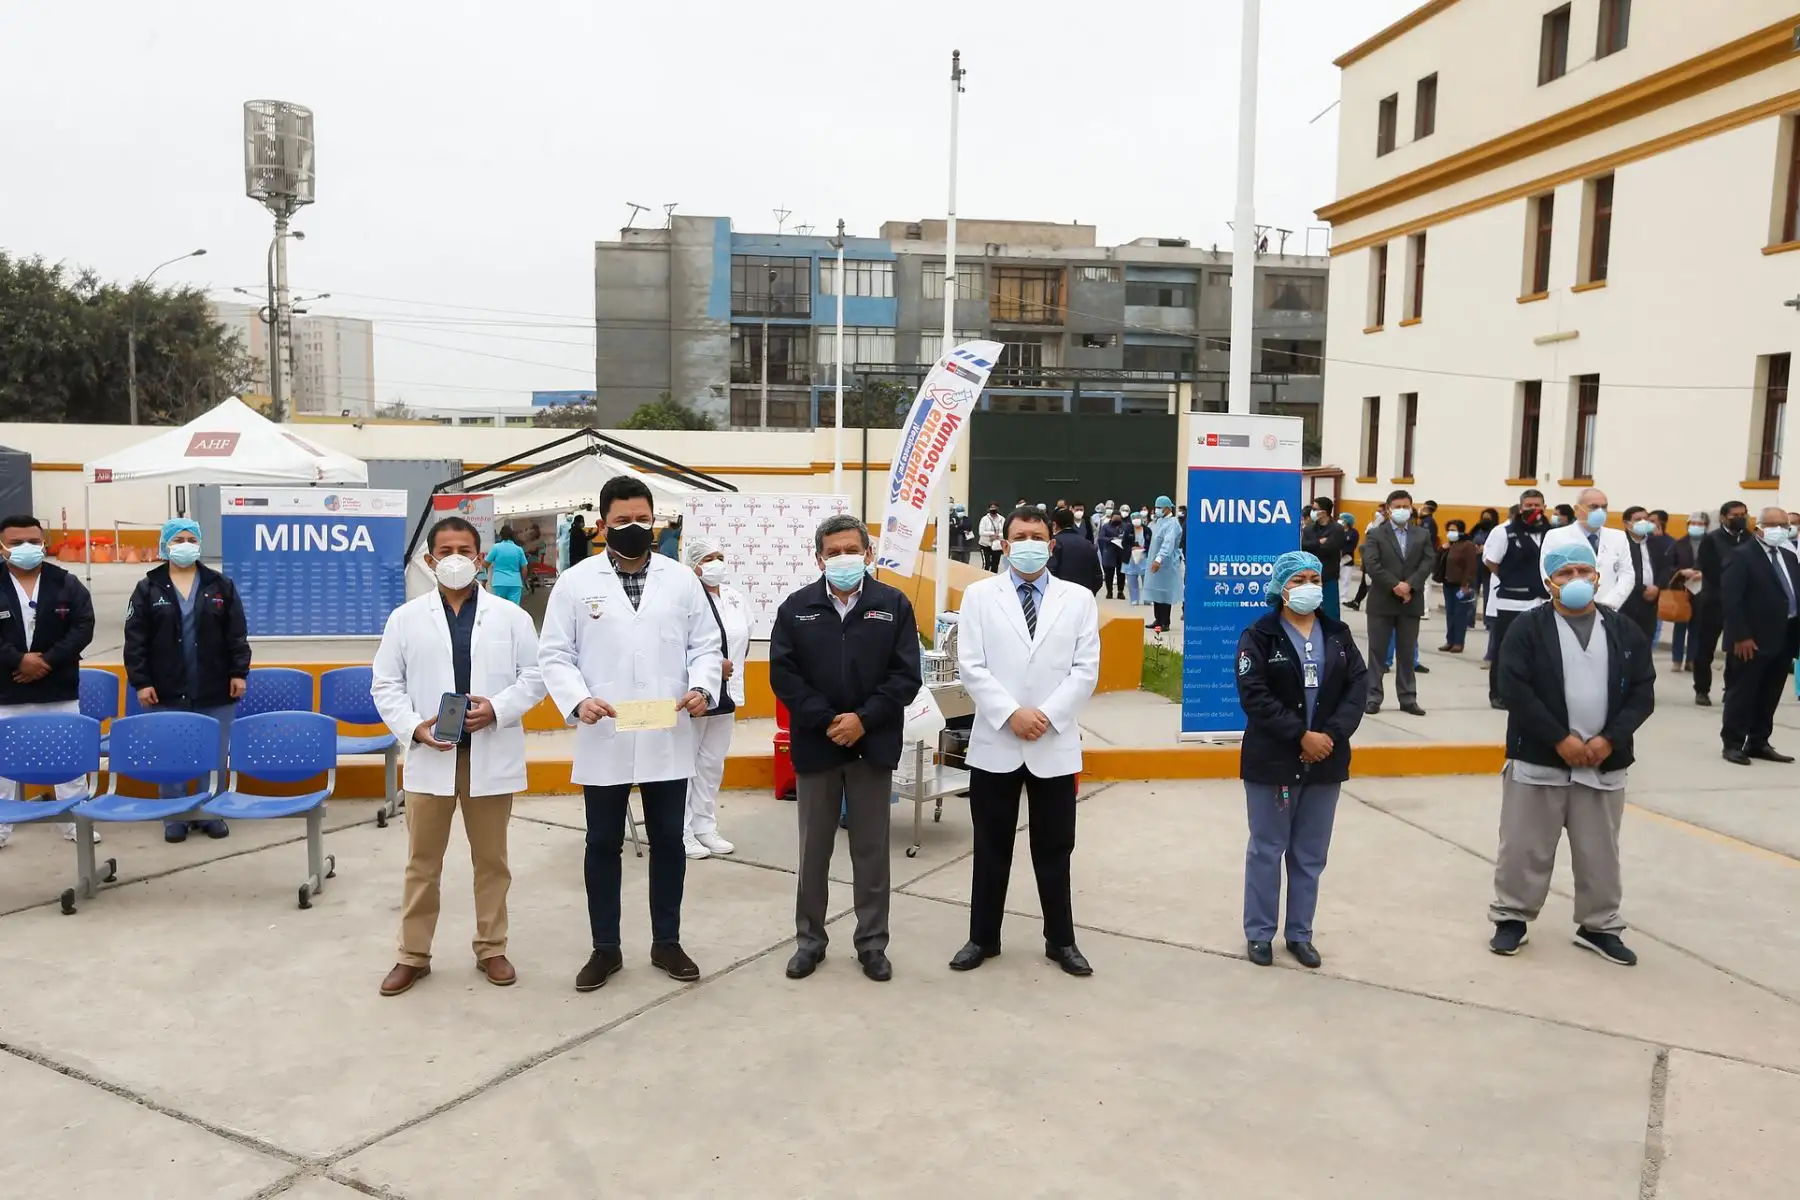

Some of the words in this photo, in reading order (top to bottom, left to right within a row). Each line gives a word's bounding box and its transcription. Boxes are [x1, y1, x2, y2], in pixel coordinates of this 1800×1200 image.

[194, 438, 231, 450] AHF
[922, 412, 962, 473] Vamos
[900, 408, 942, 501] encuentro
[917, 473, 930, 488] a
[911, 487, 927, 510] tu
[1200, 499, 1292, 524] MINSA
[255, 524, 375, 552] MINSA
[1208, 562, 1228, 576] DE
[1230, 562, 1273, 576] TODO
[1209, 554, 1219, 562] LA
[1219, 554, 1245, 562] SALUD
[1247, 555, 1277, 563] DEPEND
